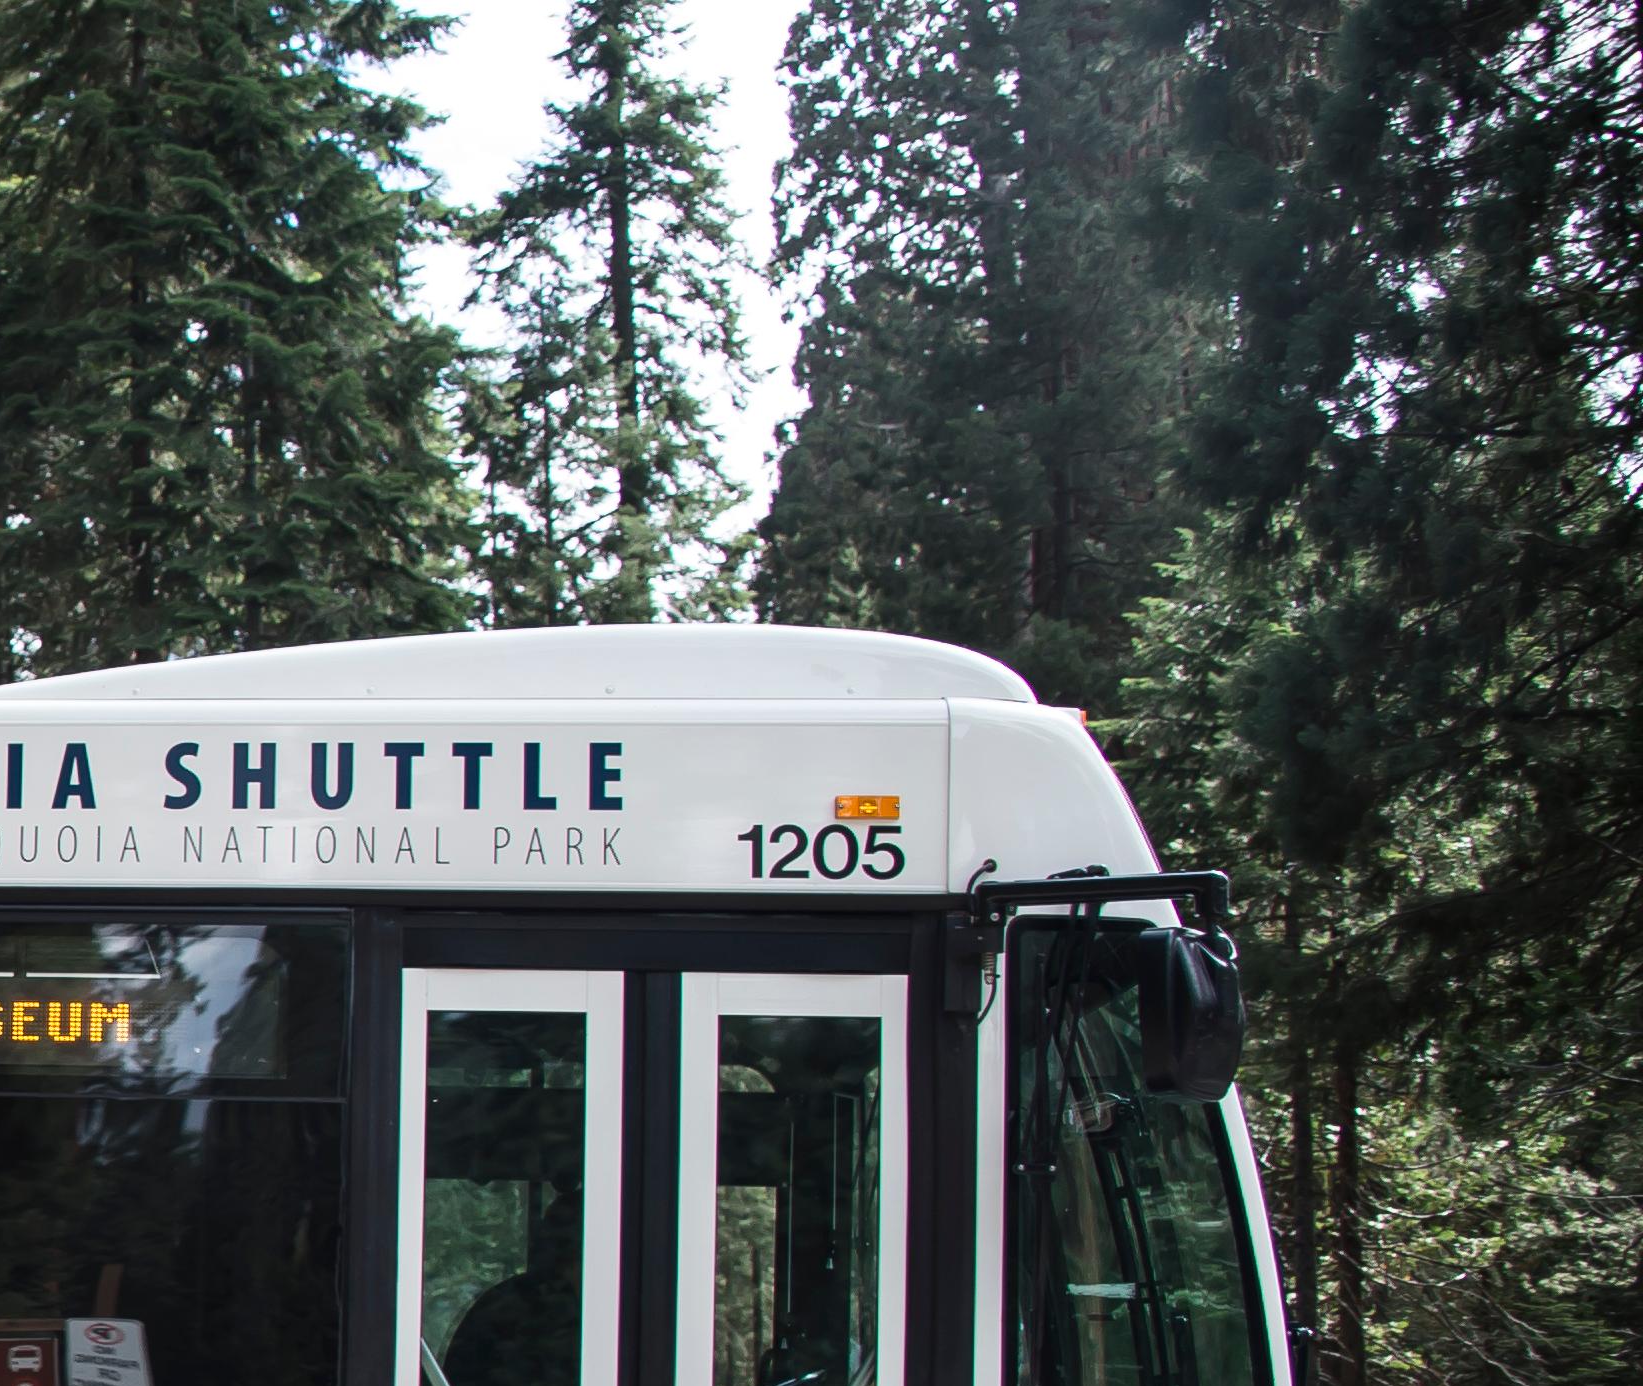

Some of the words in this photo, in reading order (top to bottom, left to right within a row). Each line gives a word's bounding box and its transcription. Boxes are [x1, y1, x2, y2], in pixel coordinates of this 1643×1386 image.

[163, 742, 623, 810] SHUTTLE
[183, 826, 451, 865] NATIONAL
[493, 827, 622, 865] PARK
[737, 823, 906, 880] 1205
